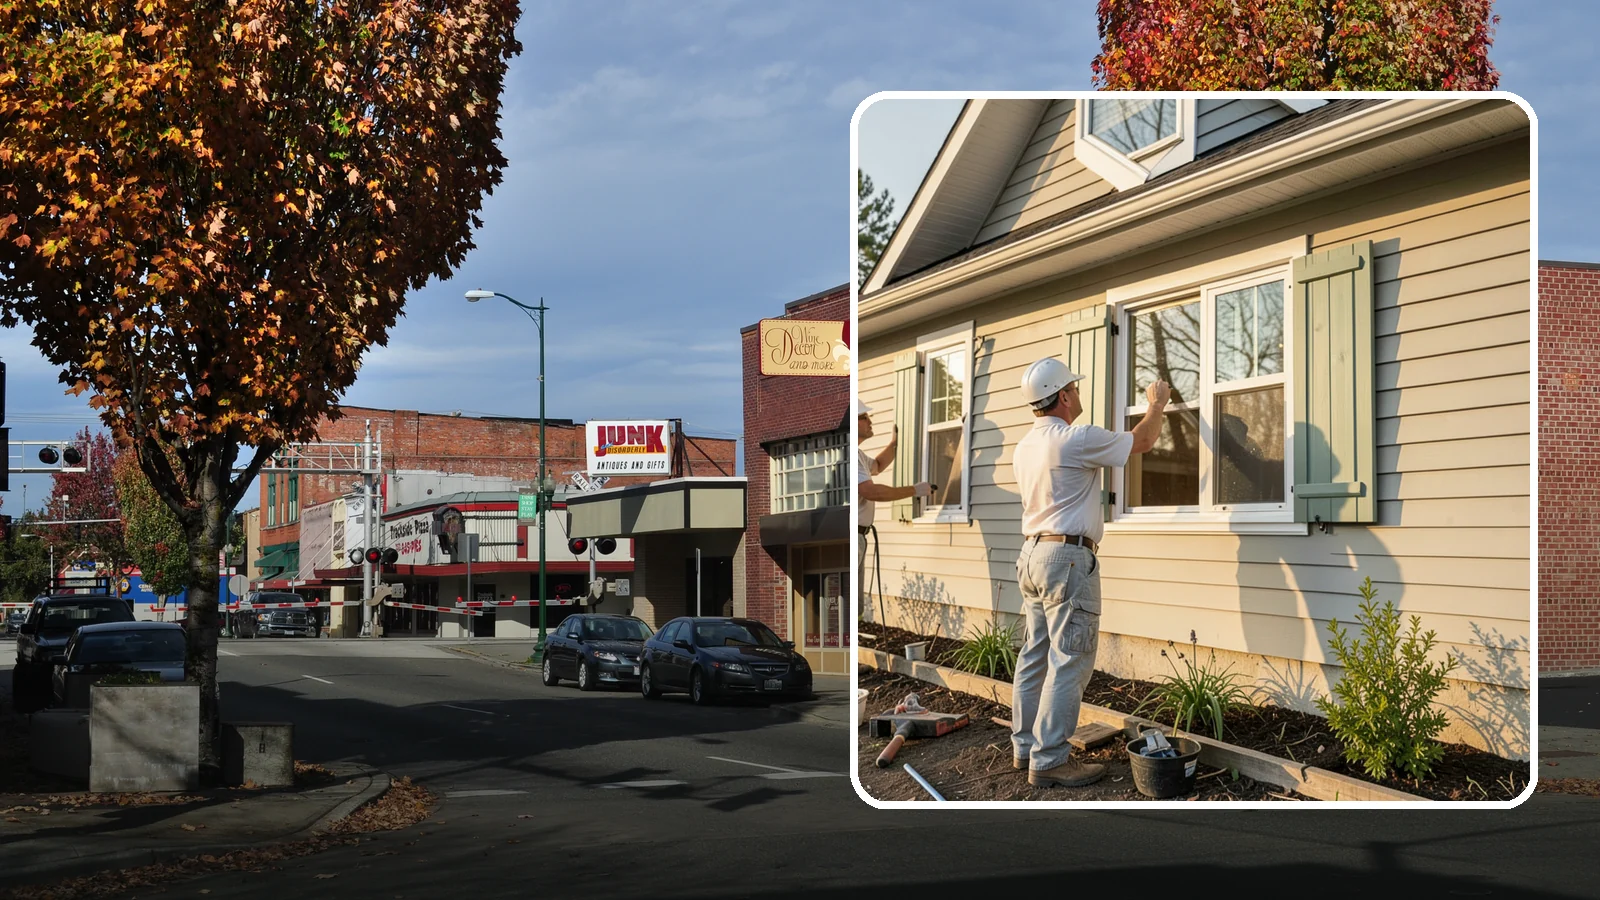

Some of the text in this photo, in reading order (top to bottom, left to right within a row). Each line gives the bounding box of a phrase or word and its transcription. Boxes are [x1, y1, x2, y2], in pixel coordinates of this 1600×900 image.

[765, 327, 831, 366] Decor
[596, 425, 664, 457] JUNK
[607, 446, 646, 454] DISORDERLY
[597, 460, 665, 470] ANTIQUES AND GIFTS
